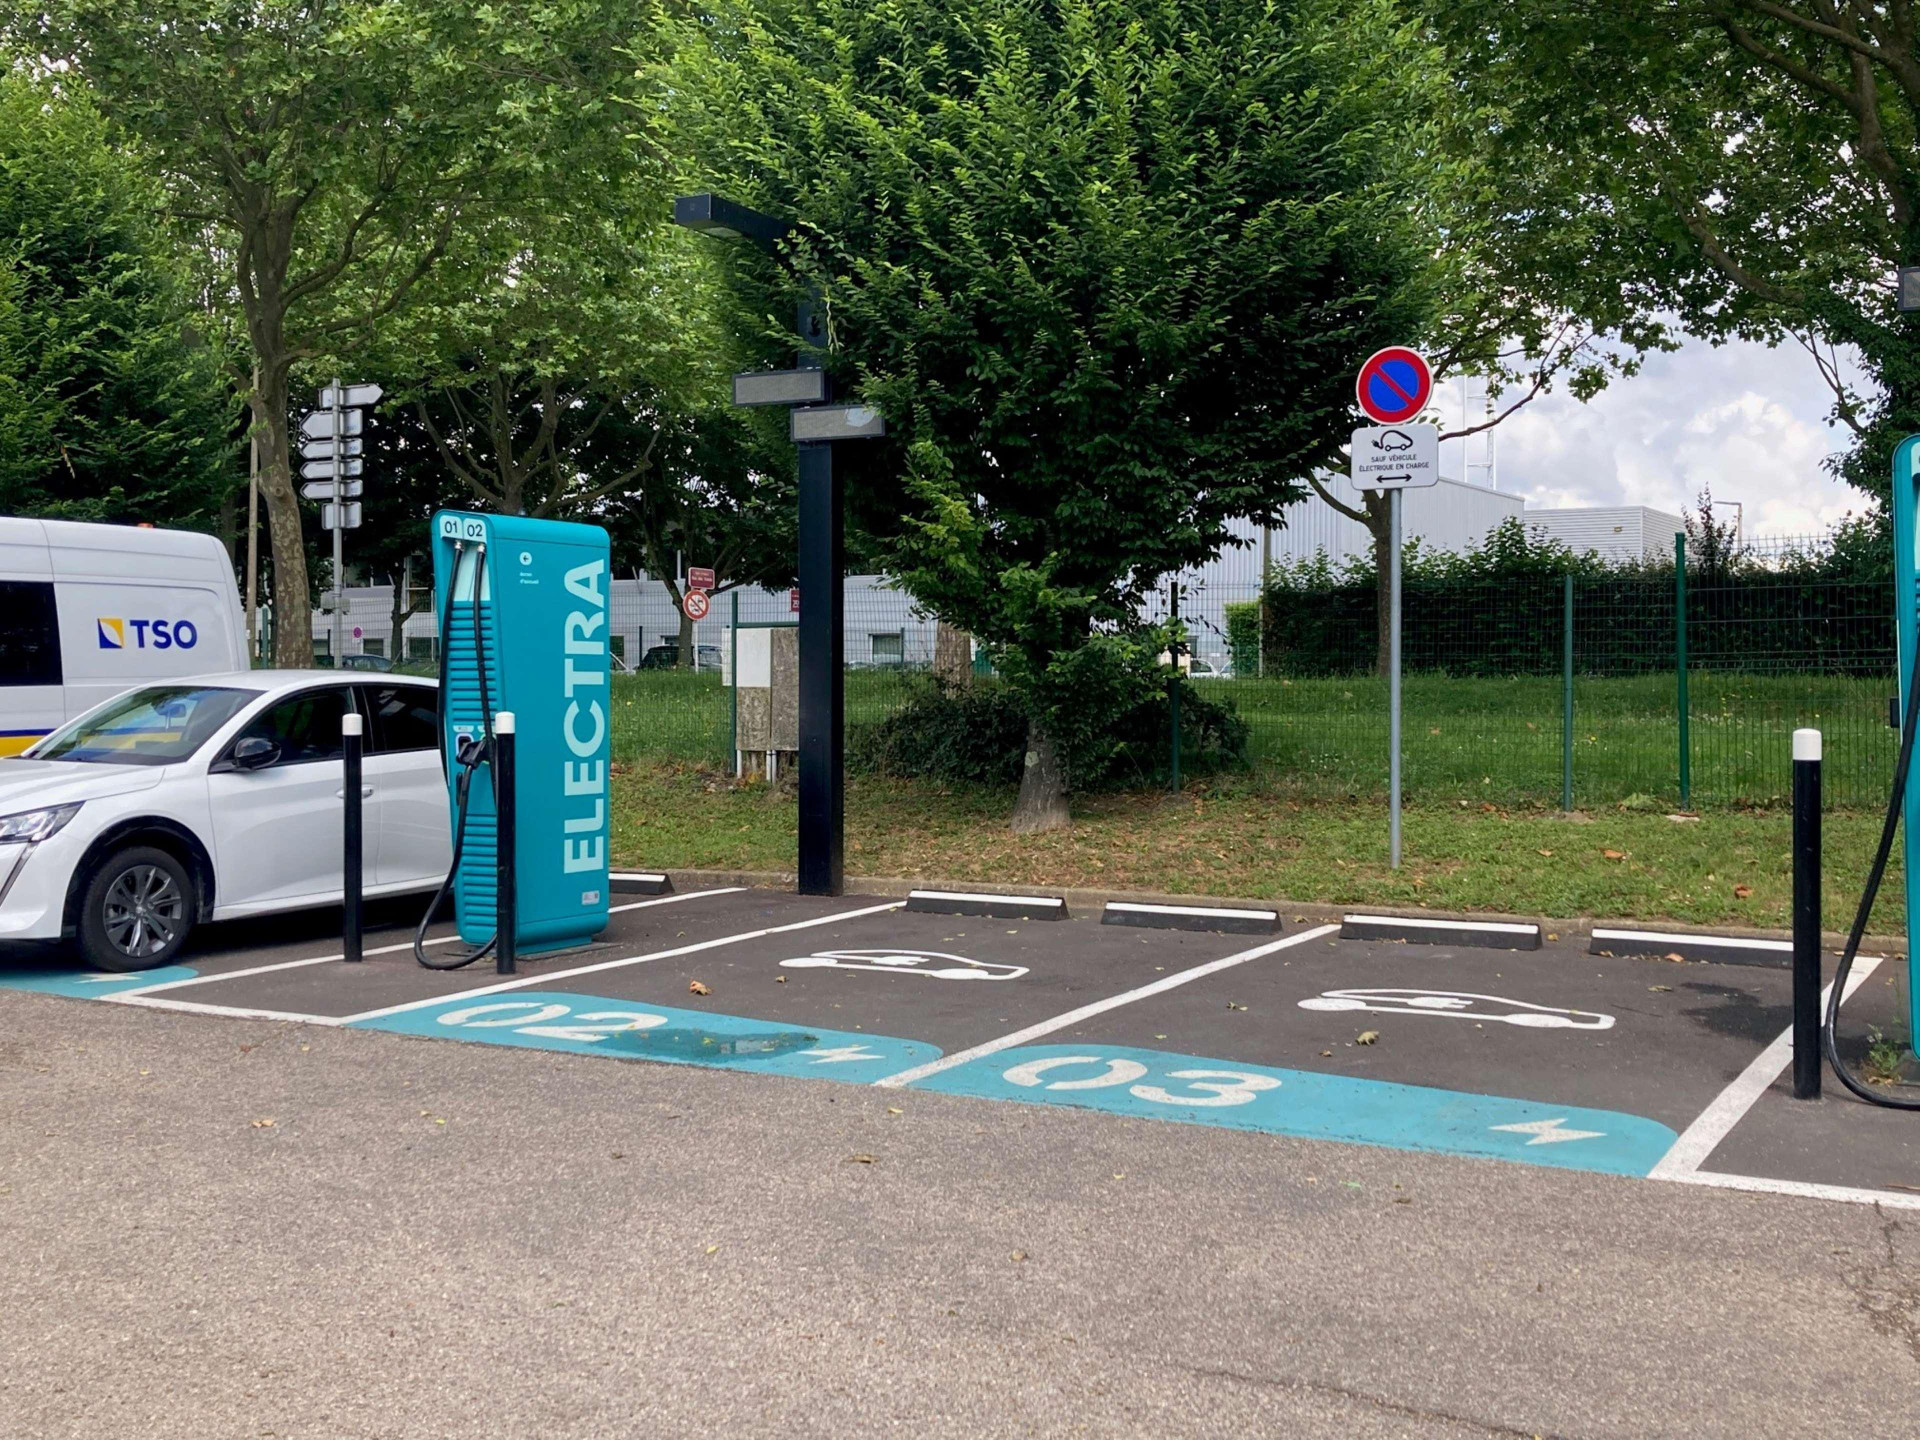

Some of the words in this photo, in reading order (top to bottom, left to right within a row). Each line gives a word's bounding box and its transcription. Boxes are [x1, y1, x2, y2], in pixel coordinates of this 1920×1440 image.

[1359, 464, 1394, 472] ÉLECTRIQUE
[1406, 461, 1429, 469] CHARGE
[1371, 455, 1387, 463] SAUF
[1389, 453, 1417, 462] VÉHICULE
[445, 520, 458, 534] 01
[467, 523, 483, 537] 02
[130, 619, 197, 649] TSO
[564, 559, 605, 874] ELECTRA
[437, 1002, 668, 1042] 02
[1002, 1055, 1283, 1107] 03
